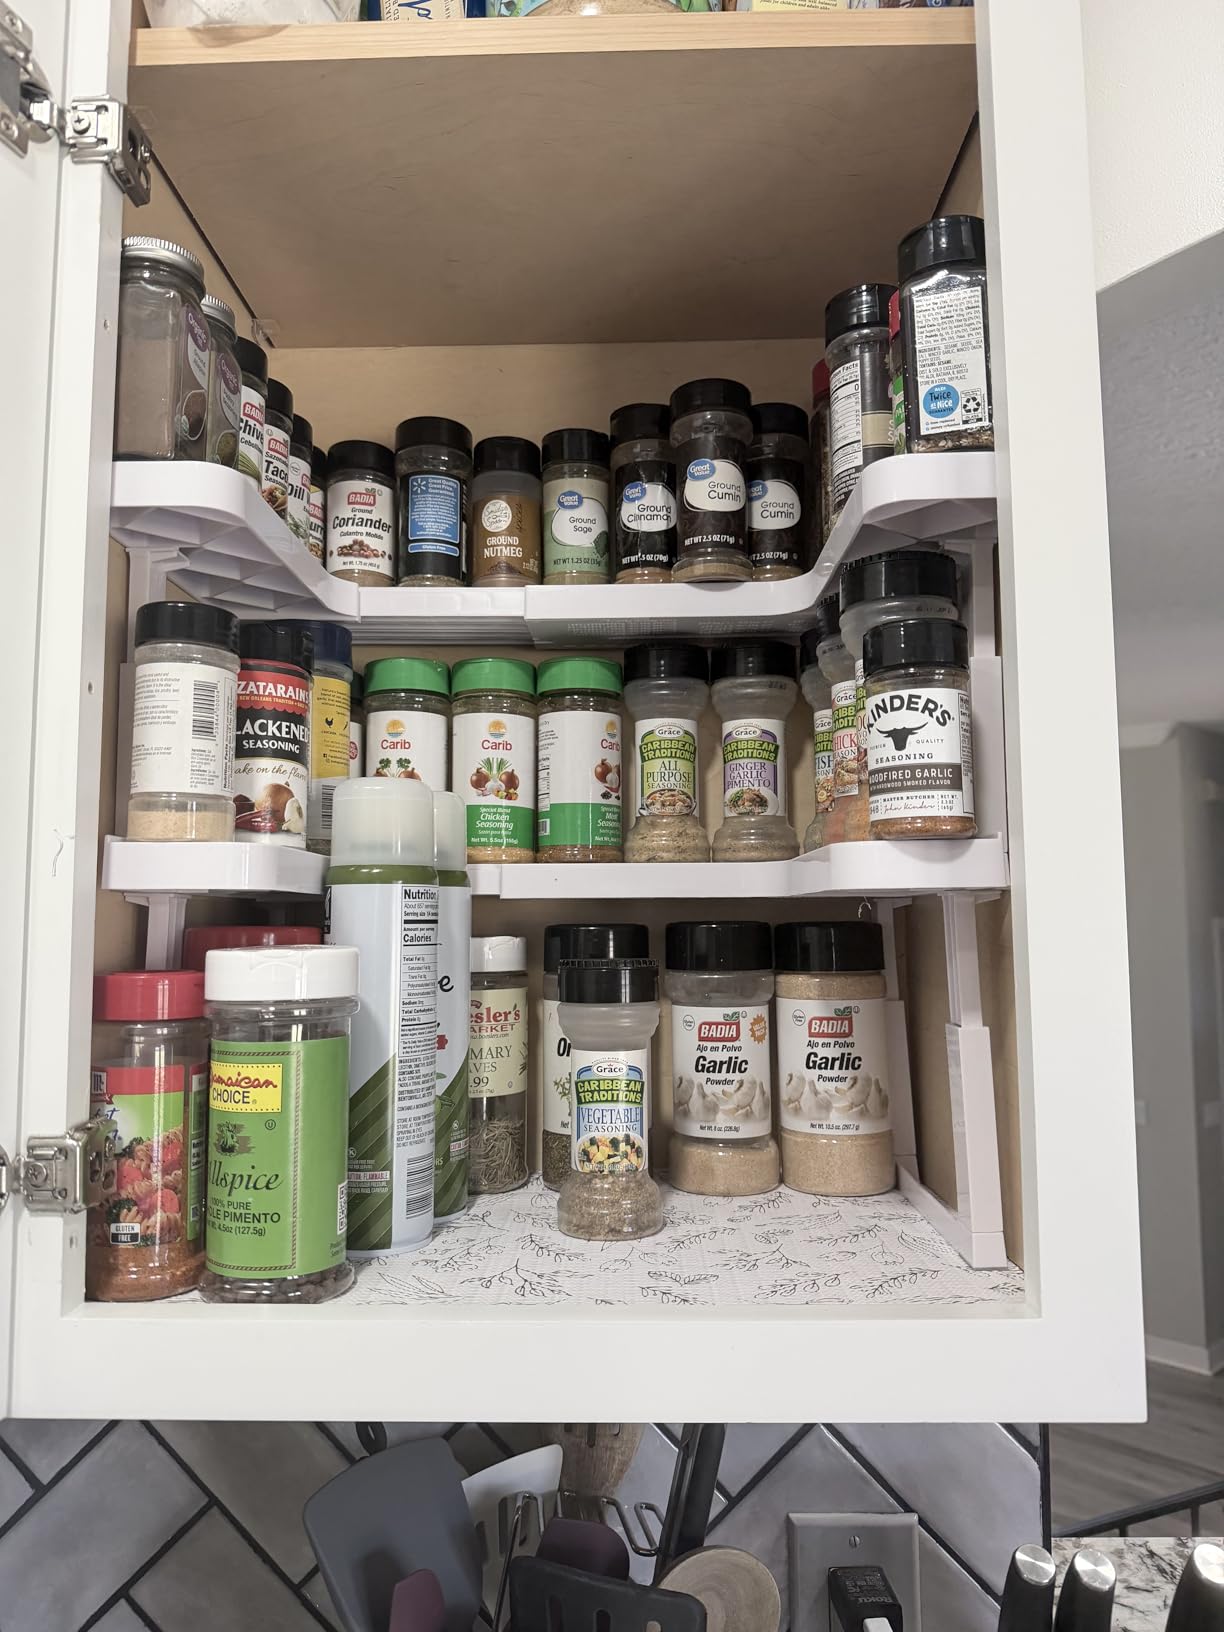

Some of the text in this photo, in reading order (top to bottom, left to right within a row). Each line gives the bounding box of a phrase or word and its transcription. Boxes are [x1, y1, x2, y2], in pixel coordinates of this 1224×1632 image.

[929, 391, 952, 402] Twice
[937, 400, 953, 409] Nice
[265, 460, 288, 484] Taco
[690, 463, 711, 473] Great
[694, 469, 711, 477] Value
[708, 481, 741, 492] Ground
[349, 493, 375, 505] BADIA
[560, 494, 578, 502] Great
[707, 490, 741, 503] Cumin
[637, 503, 672, 514] Ground
[760, 501, 794, 510] Ground
[627, 513, 672, 524] Cinnamon
[760, 509, 794, 519] Cumin
[333, 514, 393, 534] Coriander
[569, 516, 597, 525] Ground
[573, 525, 592, 534] Sage
[487, 535, 519, 546] GROUND
[484, 546, 523, 558] NUTMEG
[836, 693, 857, 703] Grace
[236, 718, 309, 743] ACKENED
[657, 728, 681, 736] Grace
[734, 728, 758, 736] Grace
[242, 739, 300, 754] SEASONING
[381, 739, 411, 750] Carib
[481, 739, 513, 751] Carib
[641, 739, 695, 754] CARIBBEAN
[723, 739, 776, 753] CARIBBEAN
[643, 748, 695, 762] TRADITIONS
[875, 752, 934, 765] SEASONING
[659, 760, 681, 771] ALL
[729, 761, 767, 772] GINGER
[815, 755, 833, 770] ISH
[234, 762, 288, 776] ake on the
[915, 768, 953, 778] GARLIC
[646, 771, 692, 783] PURPOSE
[729, 770, 767, 780] GARLIC
[647, 782, 691, 790] SEASONING
[727, 779, 771, 790] PIMENTO
[480, 813, 510, 821] Chicken
[476, 820, 514, 831] Seasoning
[403, 887, 436, 902] Nutrition
[403, 933, 432, 944] Calories
[470, 1005, 521, 1024] sler's
[470, 1024, 516, 1034] ARKET
[700, 1024, 738, 1038] BADIA
[811, 1019, 850, 1034] BADIA
[696, 1043, 743, 1053] Ajo en Polvo
[806, 1039, 856, 1049] Ajo en Polvo
[470, 1045, 512, 1060] MARY
[694, 1054, 749, 1074] Garlic
[805, 1051, 863, 1071] Garlic
[596, 1064, 624, 1073] Grace
[705, 1077, 735, 1086] Powder
[817, 1073, 848, 1083] Powder
[577, 1079, 642, 1092] CARIBBEAN
[213, 1087, 251, 1105] CHOICE
[579, 1090, 642, 1103] TRADITIONS
[580, 1106, 640, 1125] VEGETABLE
[583, 1123, 637, 1133] SEASONING
[209, 1159, 284, 1197] llspice
[227, 1200, 252, 1211] PURE
[223, 1210, 281, 1224] PIMENTO
[115, 1224, 135, 1232] GLUTEN
[234, 1226, 266, 1237] (127.5g)
